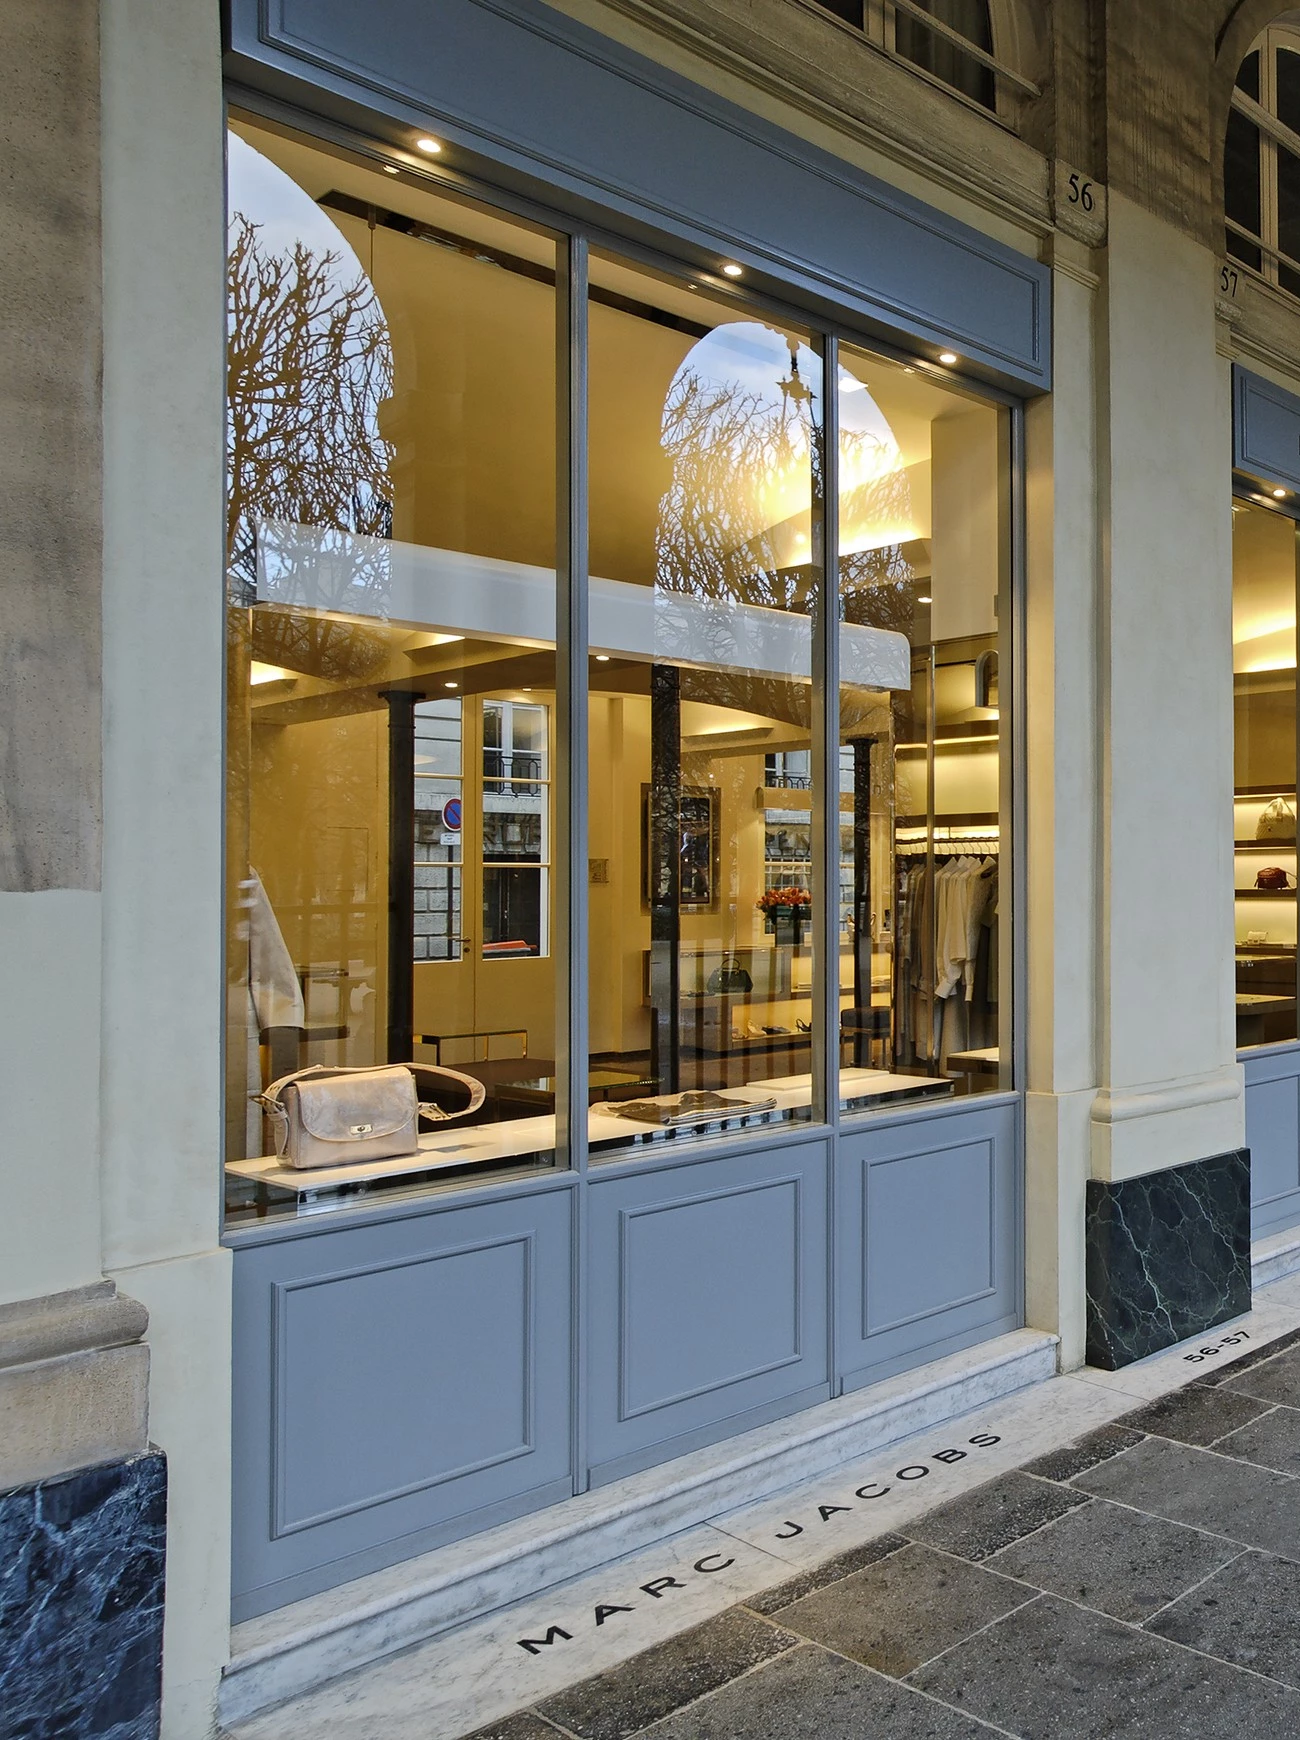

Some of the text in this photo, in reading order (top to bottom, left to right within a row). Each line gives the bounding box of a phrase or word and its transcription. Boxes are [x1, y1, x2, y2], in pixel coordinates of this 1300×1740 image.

[1069, 173, 1093, 212] 56
[1221, 265, 1238, 298] 57
[1182, 1331, 1250, 1363] 56-57
[517, 1432, 1002, 1655] MARC JACOBS
